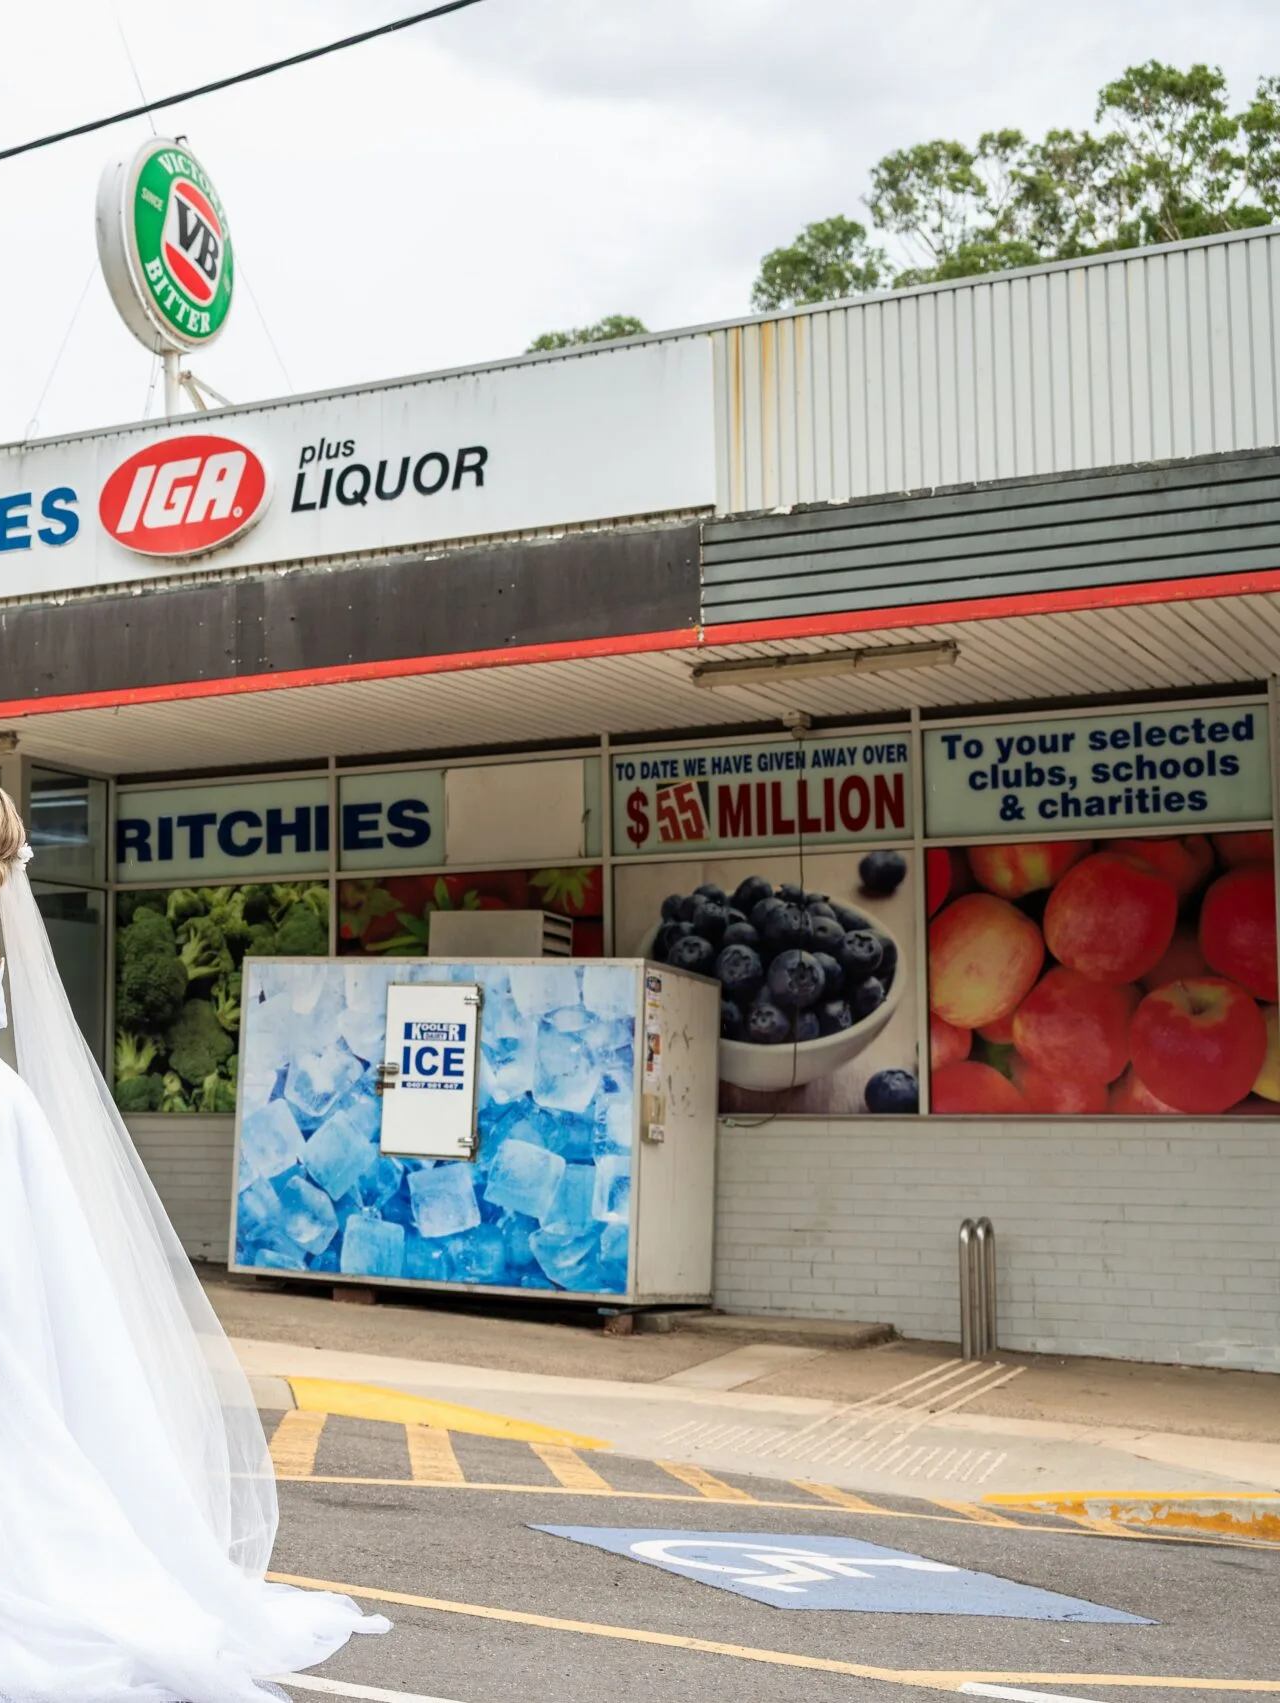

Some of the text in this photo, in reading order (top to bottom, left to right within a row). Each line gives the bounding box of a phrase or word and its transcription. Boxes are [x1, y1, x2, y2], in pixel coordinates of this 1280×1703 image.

[174, 195, 219, 281] VB
[145, 256, 212, 333] BITTER
[298, 437, 355, 469] plus
[115, 449, 247, 534] IGA
[290, 446, 489, 514] LIQUOR
[941, 713, 1254, 763] To your selected
[616, 743, 907, 781] TO DATE WE HAVE GIVEN AWAY OVER
[968, 750, 1241, 790] clubs, schools
[718, 773, 906, 838] MILLION
[999, 786, 1208, 821] & charities
[117, 799, 432, 864] RITCHIES
[411, 1023, 460, 1041] KOOLER
[402, 1046, 465, 1077] ICE
